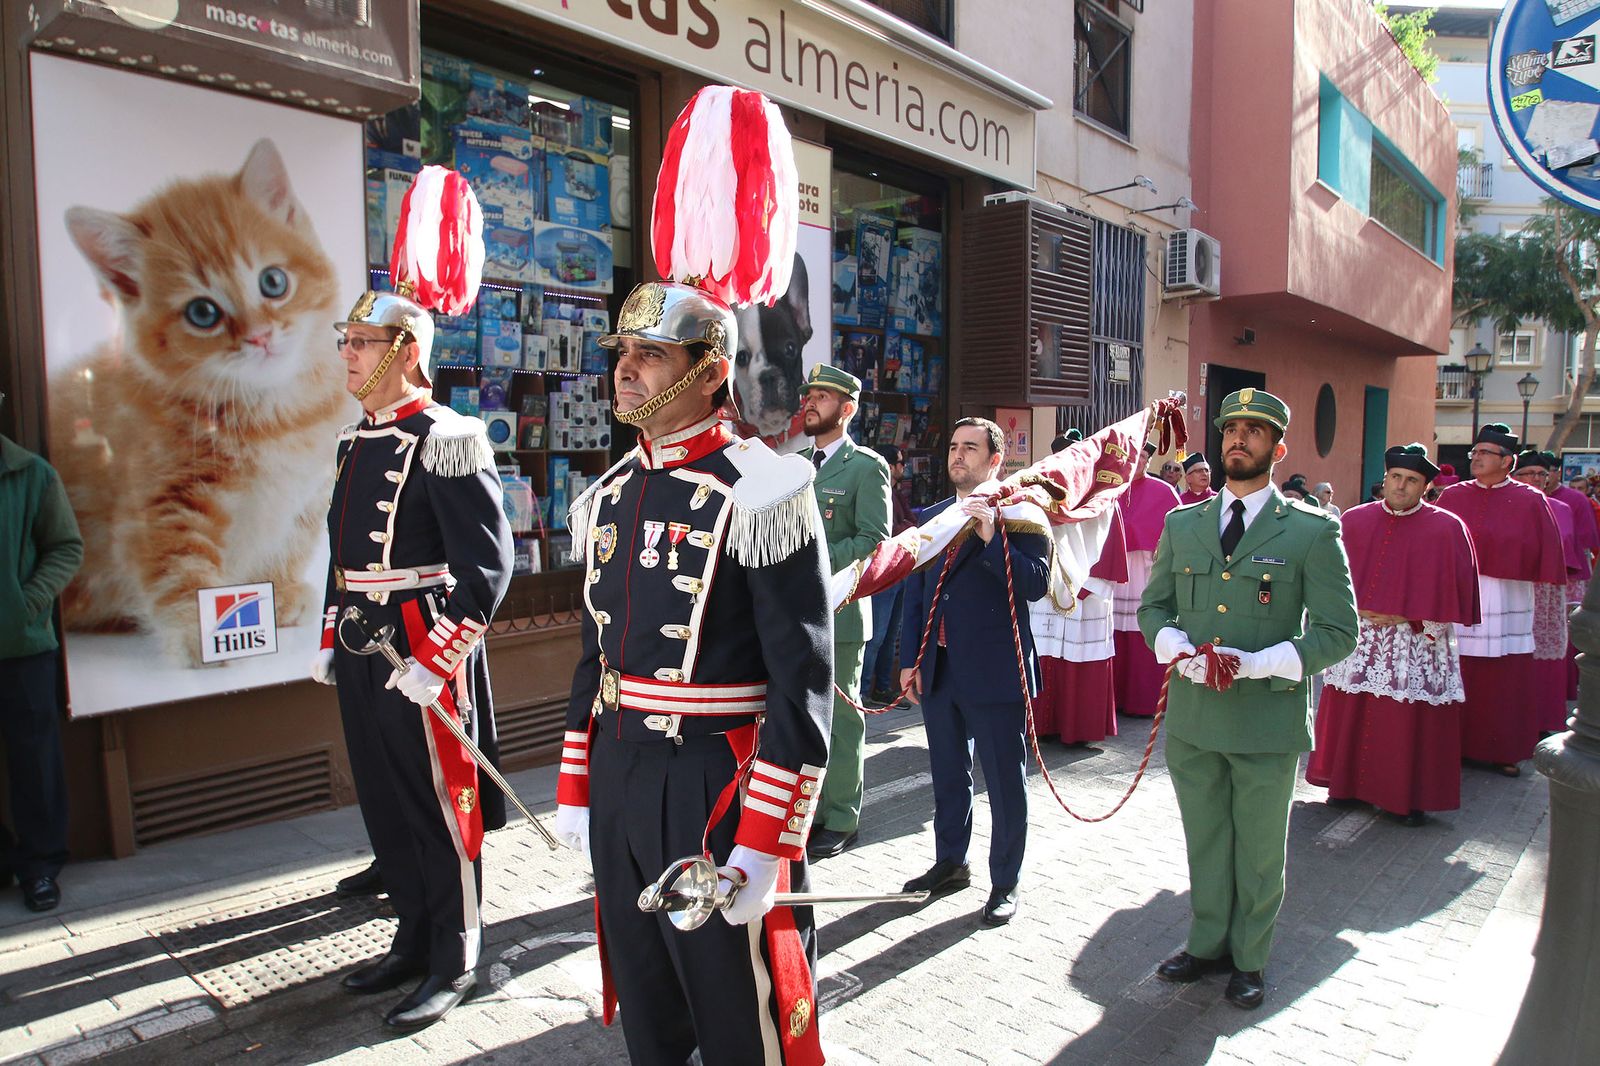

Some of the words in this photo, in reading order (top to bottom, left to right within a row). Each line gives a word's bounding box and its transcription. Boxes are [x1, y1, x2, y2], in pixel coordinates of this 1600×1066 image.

[302, 30, 393, 67] almeria.com
[745, 9, 1011, 165] almeria.com
[798, 182, 819, 198] ara
[798, 198, 819, 214] ota
[213, 630, 266, 653] Hill's
